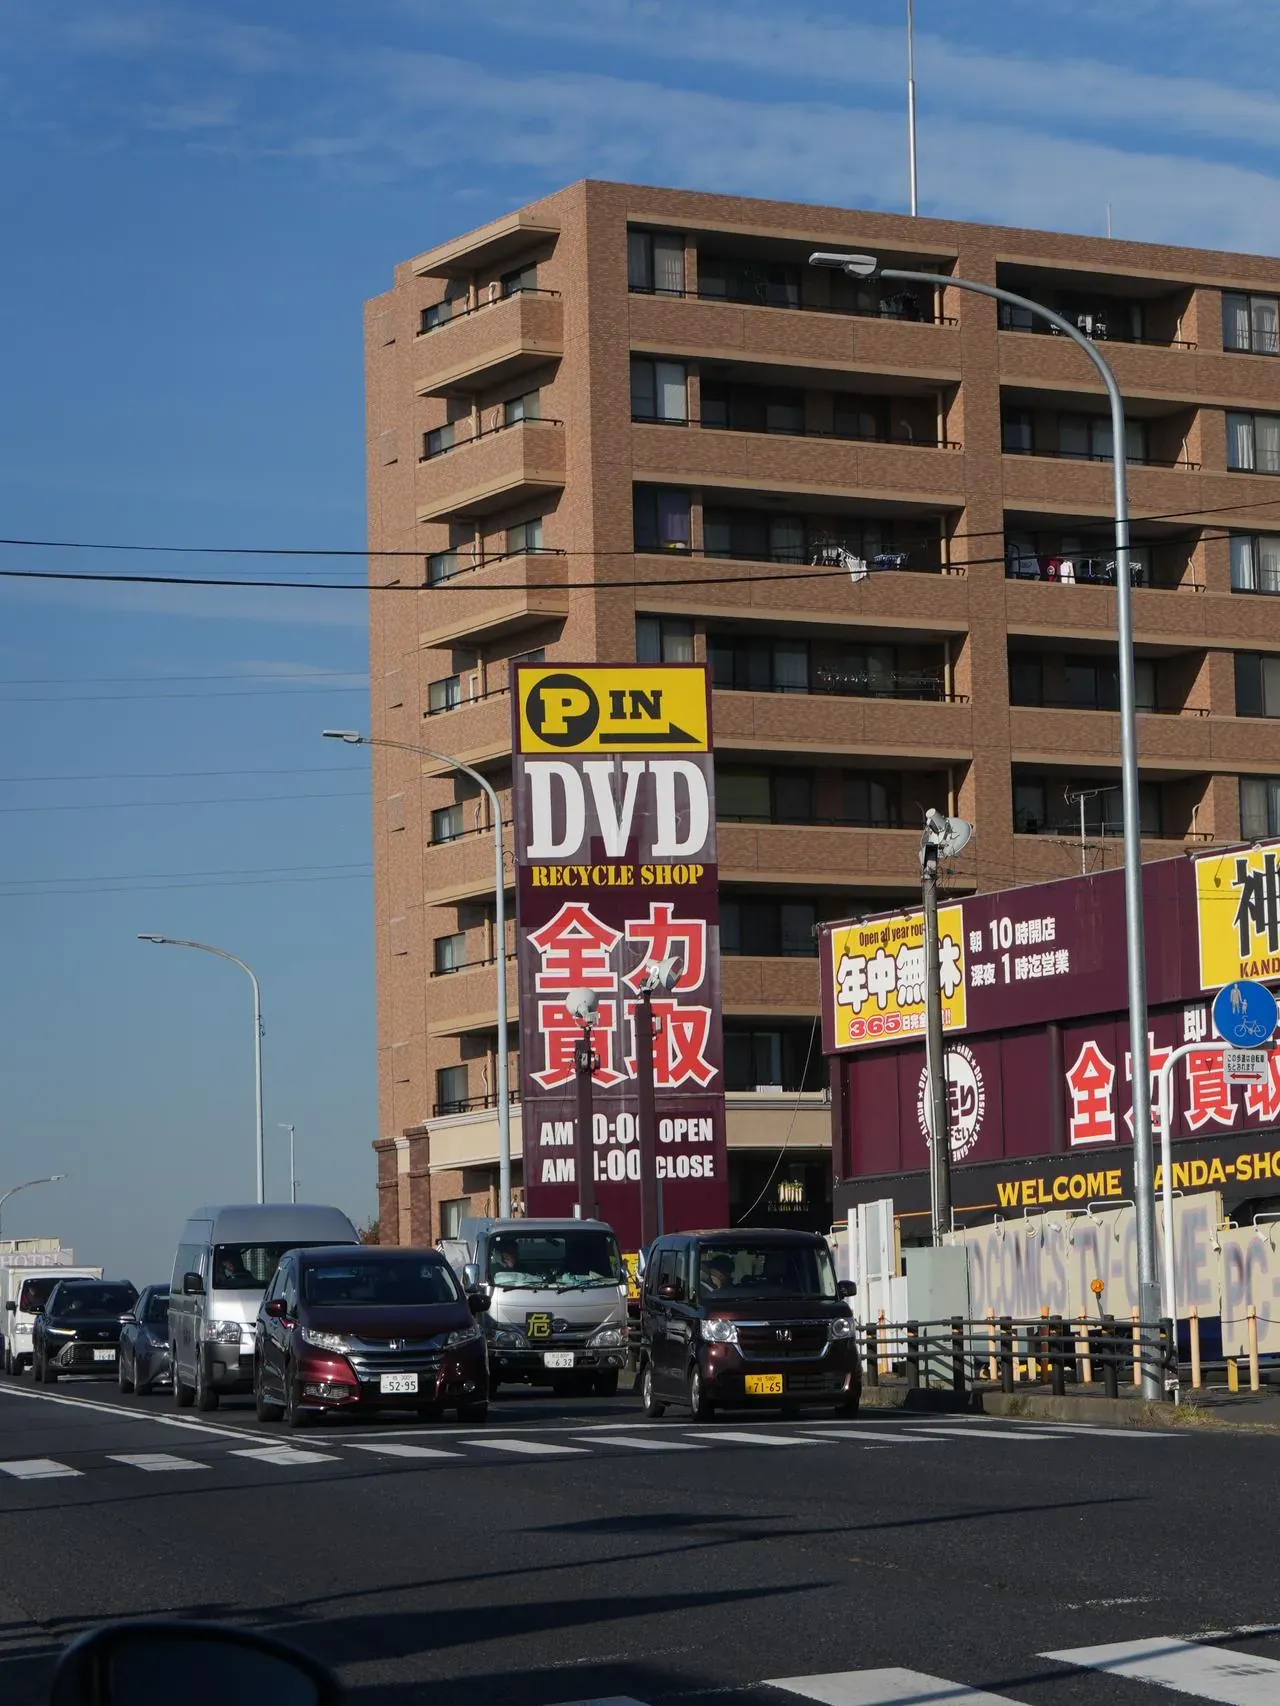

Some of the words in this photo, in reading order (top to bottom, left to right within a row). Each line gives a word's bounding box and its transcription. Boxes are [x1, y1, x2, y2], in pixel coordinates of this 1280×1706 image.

[609, 690, 662, 719] IN
[524, 760, 709, 859] DVD
[531, 865, 634, 887] RECYCLE
[641, 864, 704, 885] SHOP
[526, 902, 707, 995] 全力
[859, 930, 879, 946] Open
[881, 926, 891, 943] all
[892, 923, 910, 943] year
[528, 998, 719, 1092] 買取
[540, 1121, 574, 1146] AM
[659, 1117, 713, 1143] OPEN
[542, 1157, 576, 1183] AM
[655, 1154, 714, 1179] CLOSE
[997, 1169, 1122, 1208] WELCOME
[527, 1313, 551, 1337] 危
